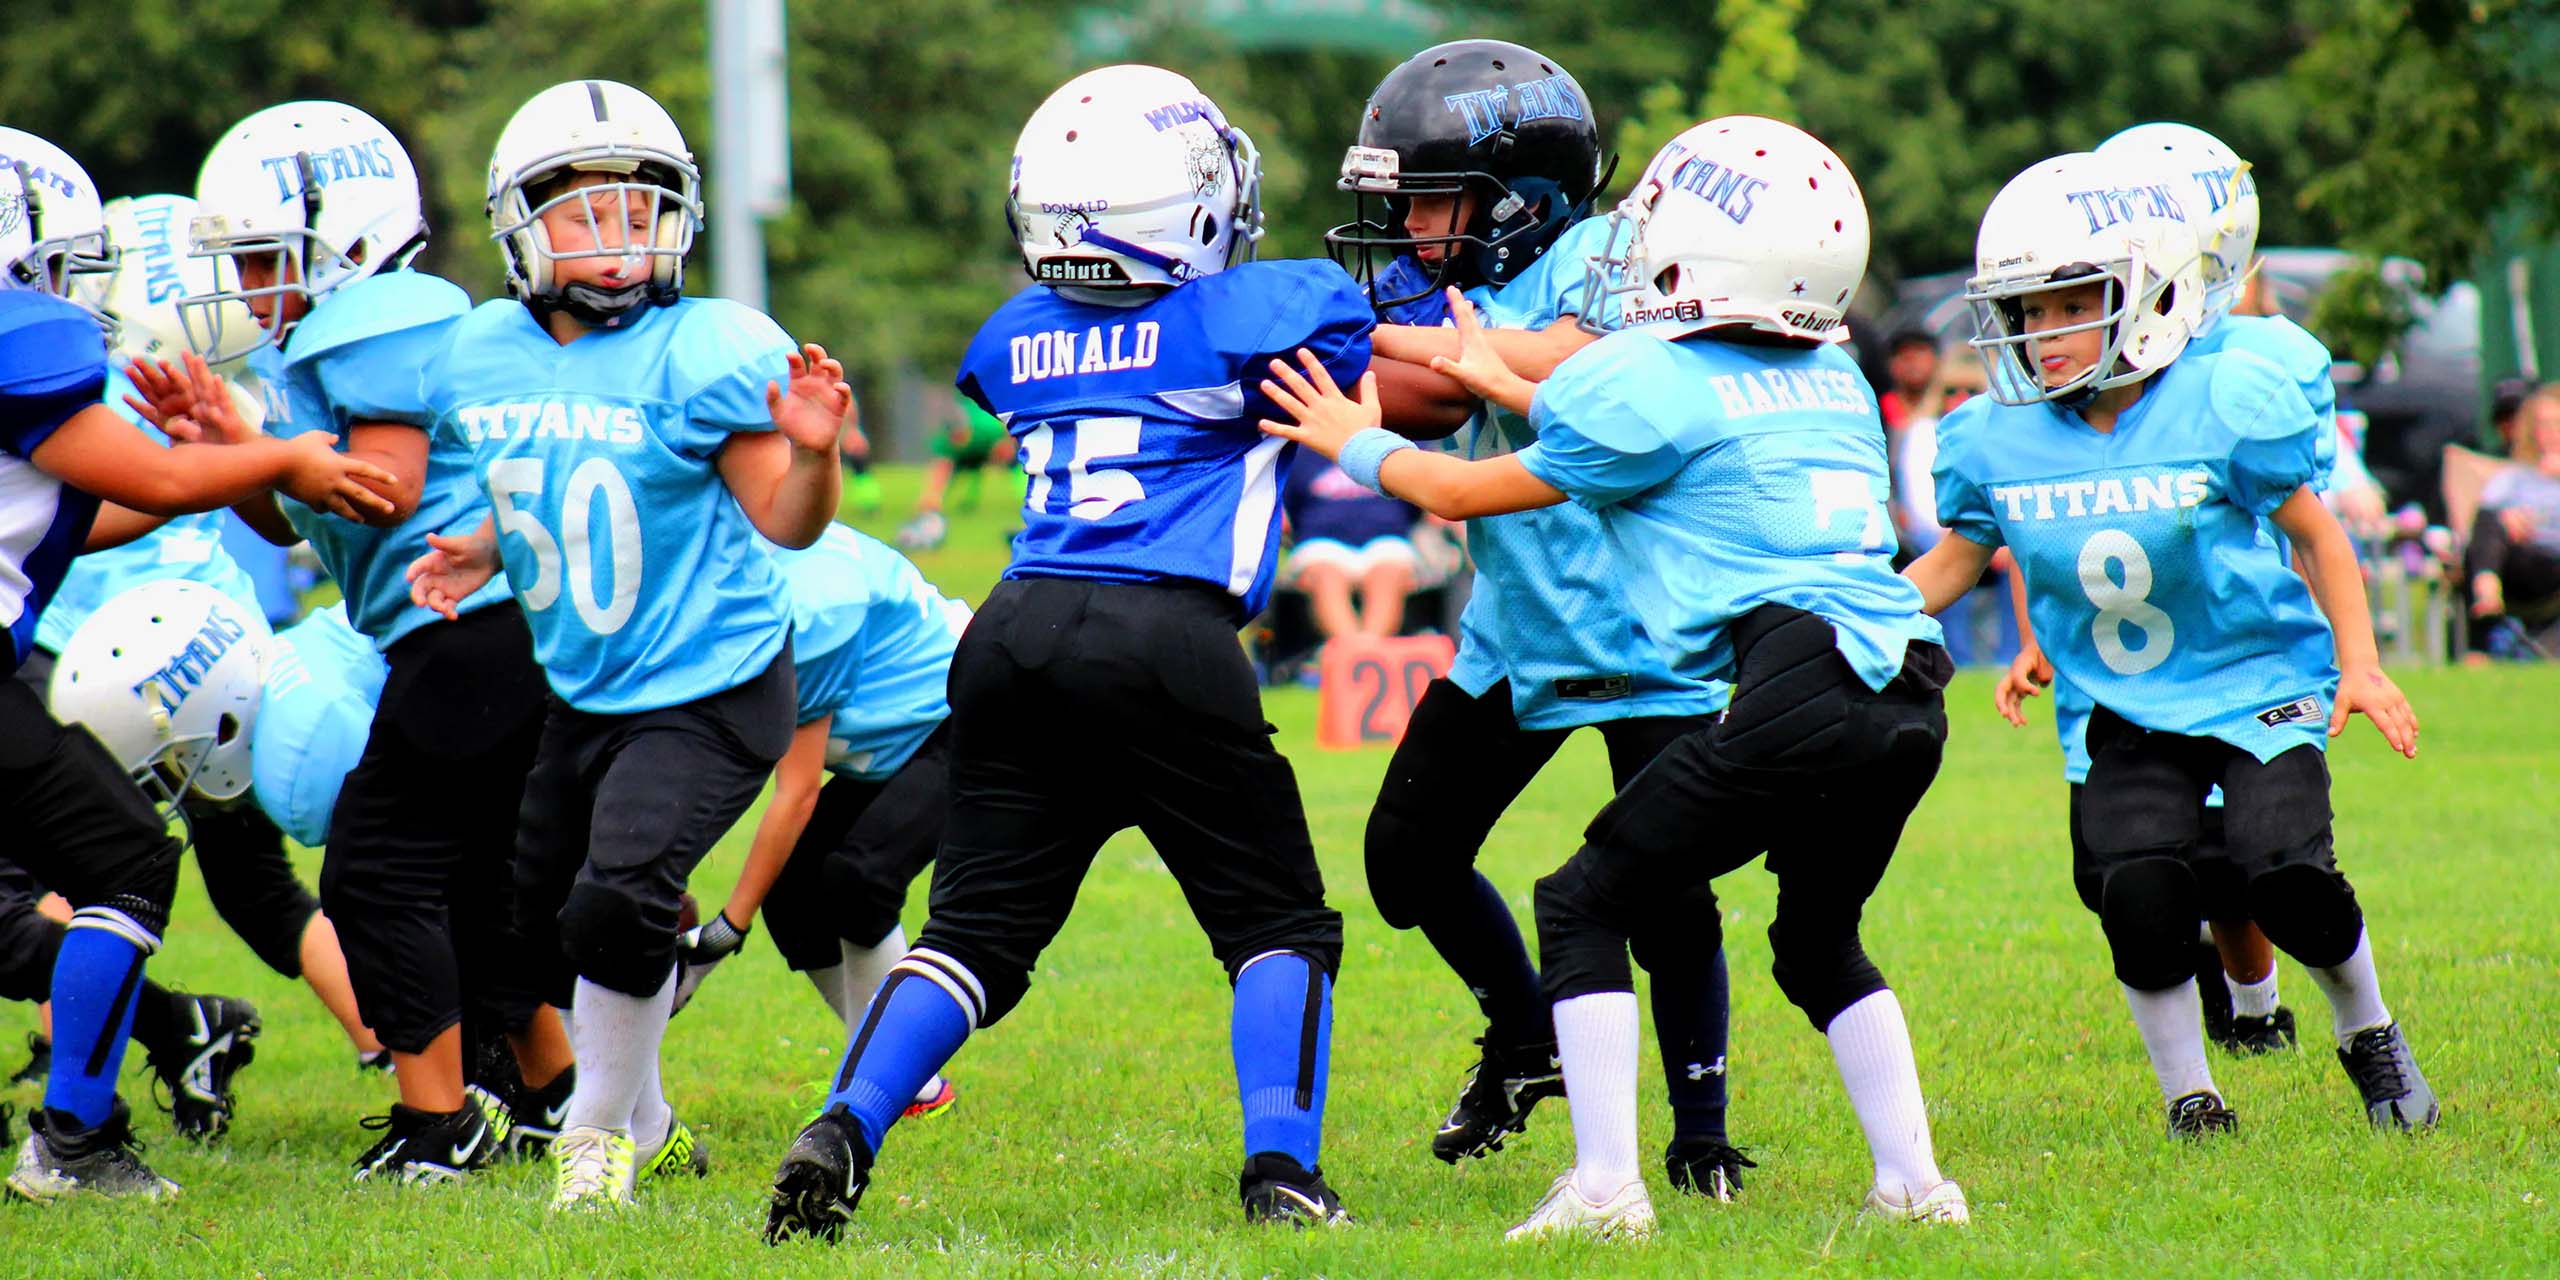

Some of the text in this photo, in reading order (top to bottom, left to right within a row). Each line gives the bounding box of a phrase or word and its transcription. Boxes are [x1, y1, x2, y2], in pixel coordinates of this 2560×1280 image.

[1041, 199, 1108, 215] DONALD
[1041, 261, 1112, 280] schutt
[1010, 321, 1160, 384] DONALD
[458, 402, 643, 443] TITANS
[1019, 415, 1146, 521] 15
[1993, 472, 2208, 522] TITANS
[487, 457, 643, 635] 50
[2078, 529, 2175, 676] 8
